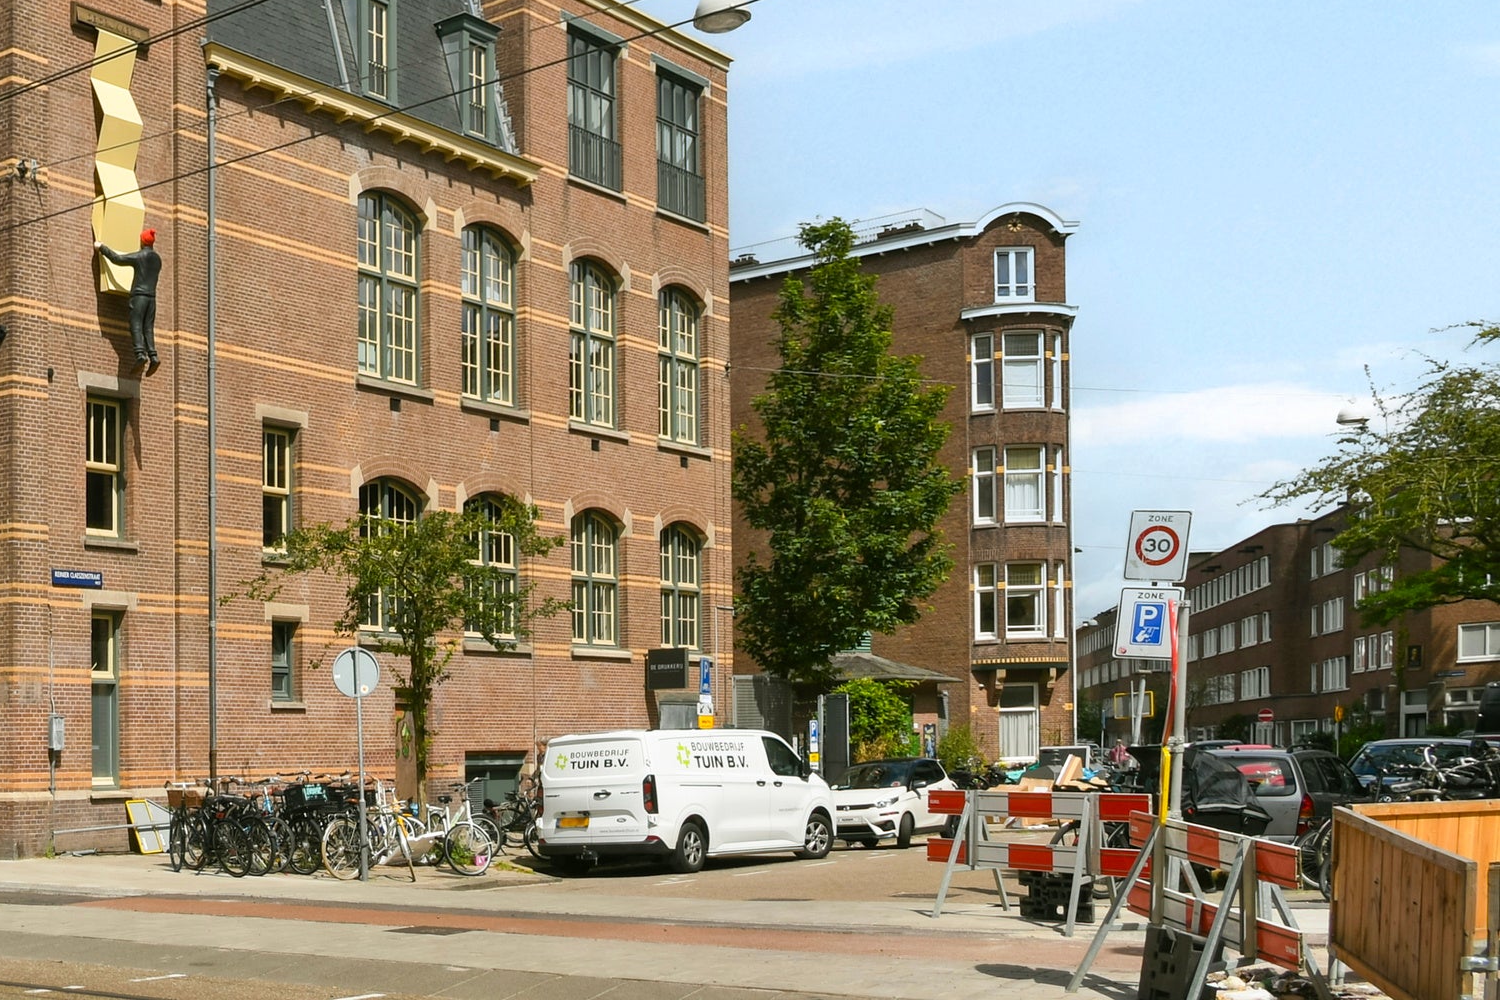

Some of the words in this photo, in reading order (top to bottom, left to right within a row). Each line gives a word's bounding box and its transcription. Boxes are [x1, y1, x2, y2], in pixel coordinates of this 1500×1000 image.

[1148, 514, 1175, 523] ZONE
[1144, 538, 1171, 553] 30
[1137, 592, 1165, 600] ZONE
[1139, 605, 1159, 628] P
[690, 741, 745, 752] BOUWBEDRIJF
[570, 748, 630, 760] BOUWBEDRIJF
[570, 759, 600, 770] TUIN
[603, 758, 629, 768] B.V.
[694, 755, 724, 769] TUIN
[726, 755, 749, 768] B.V.
